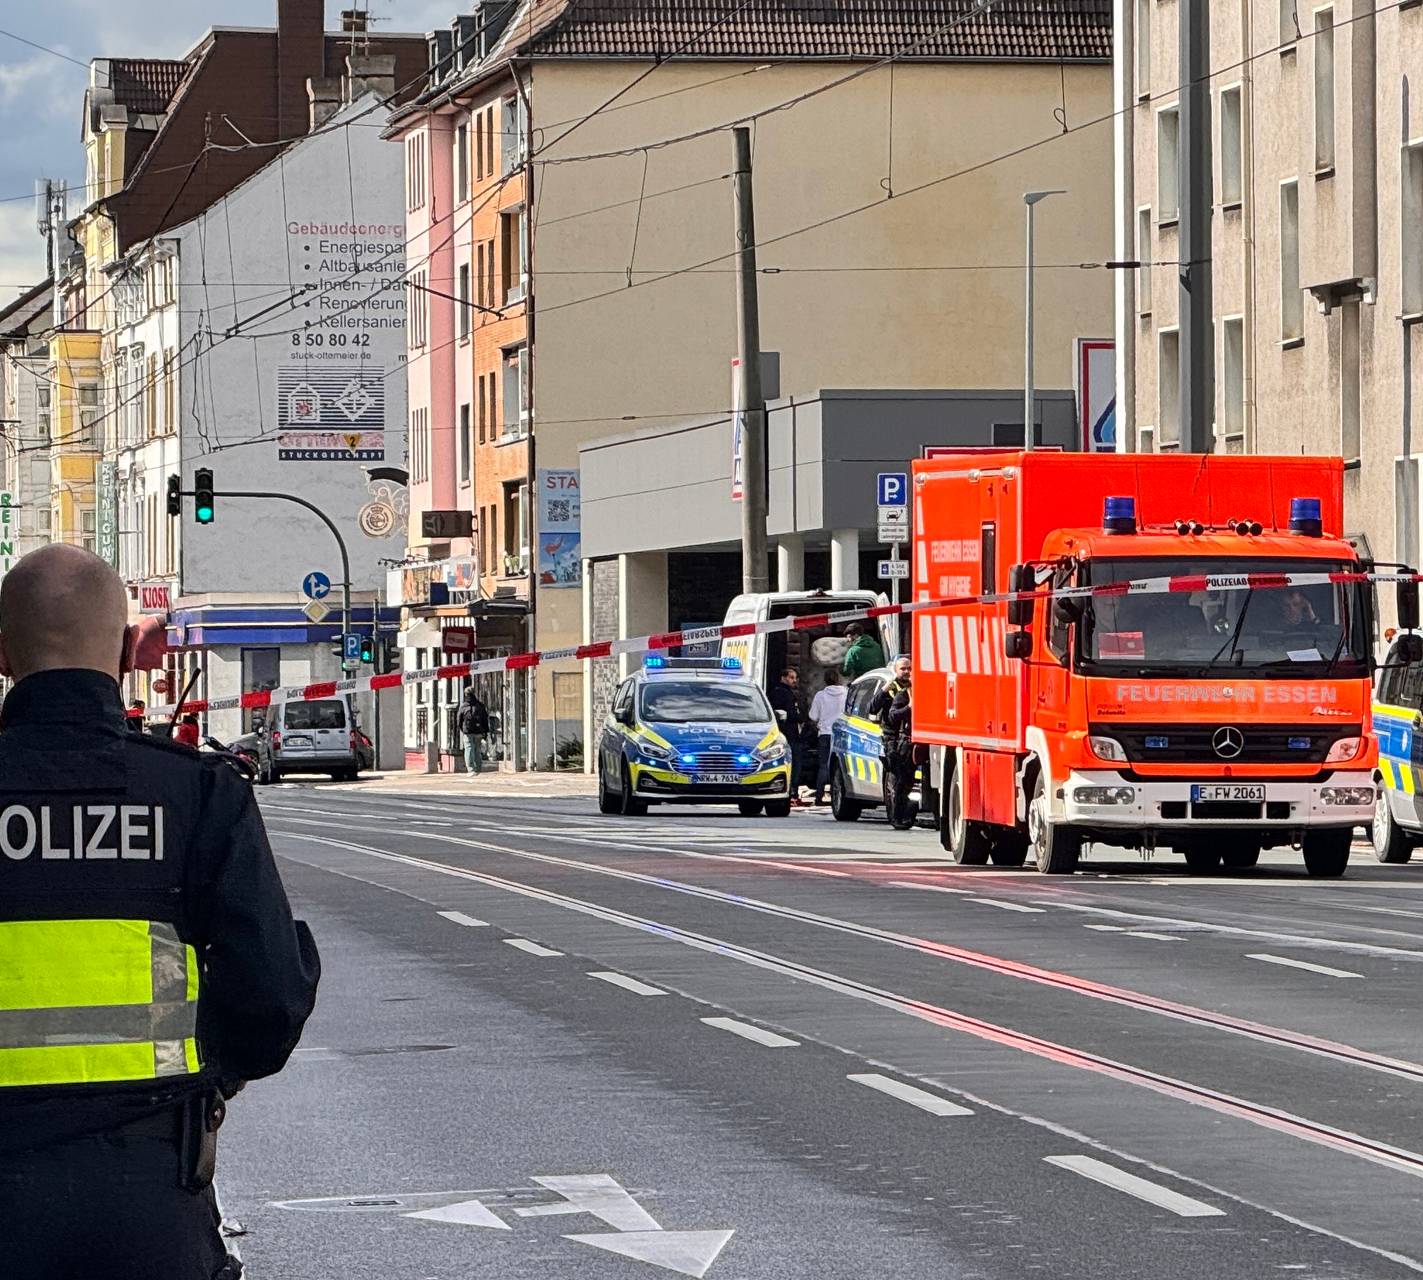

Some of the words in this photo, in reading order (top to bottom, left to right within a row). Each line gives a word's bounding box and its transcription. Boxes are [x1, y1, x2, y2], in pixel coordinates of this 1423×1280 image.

[320, 278, 366, 291] Innen-
[320, 296, 407, 311] Renovierun
[292, 333, 301, 347] 8
[305, 333, 323, 347] 50
[329, 333, 346, 347] 80
[352, 333, 370, 347] 42
[884, 478, 900, 503] P
[102, 464, 113, 562] REINIGUN
[142, 587, 170, 608] KIOSK
[347, 636, 357, 656] P
[1116, 684, 1255, 703] FEUERWEHR
[1263, 686, 1337, 703] ESSEN
[1199, 787, 1206, 799] E
[1215, 787, 1231, 799] FW
[1234, 787, 1263, 799] 2061
[0, 804, 164, 860] OLIZEI
